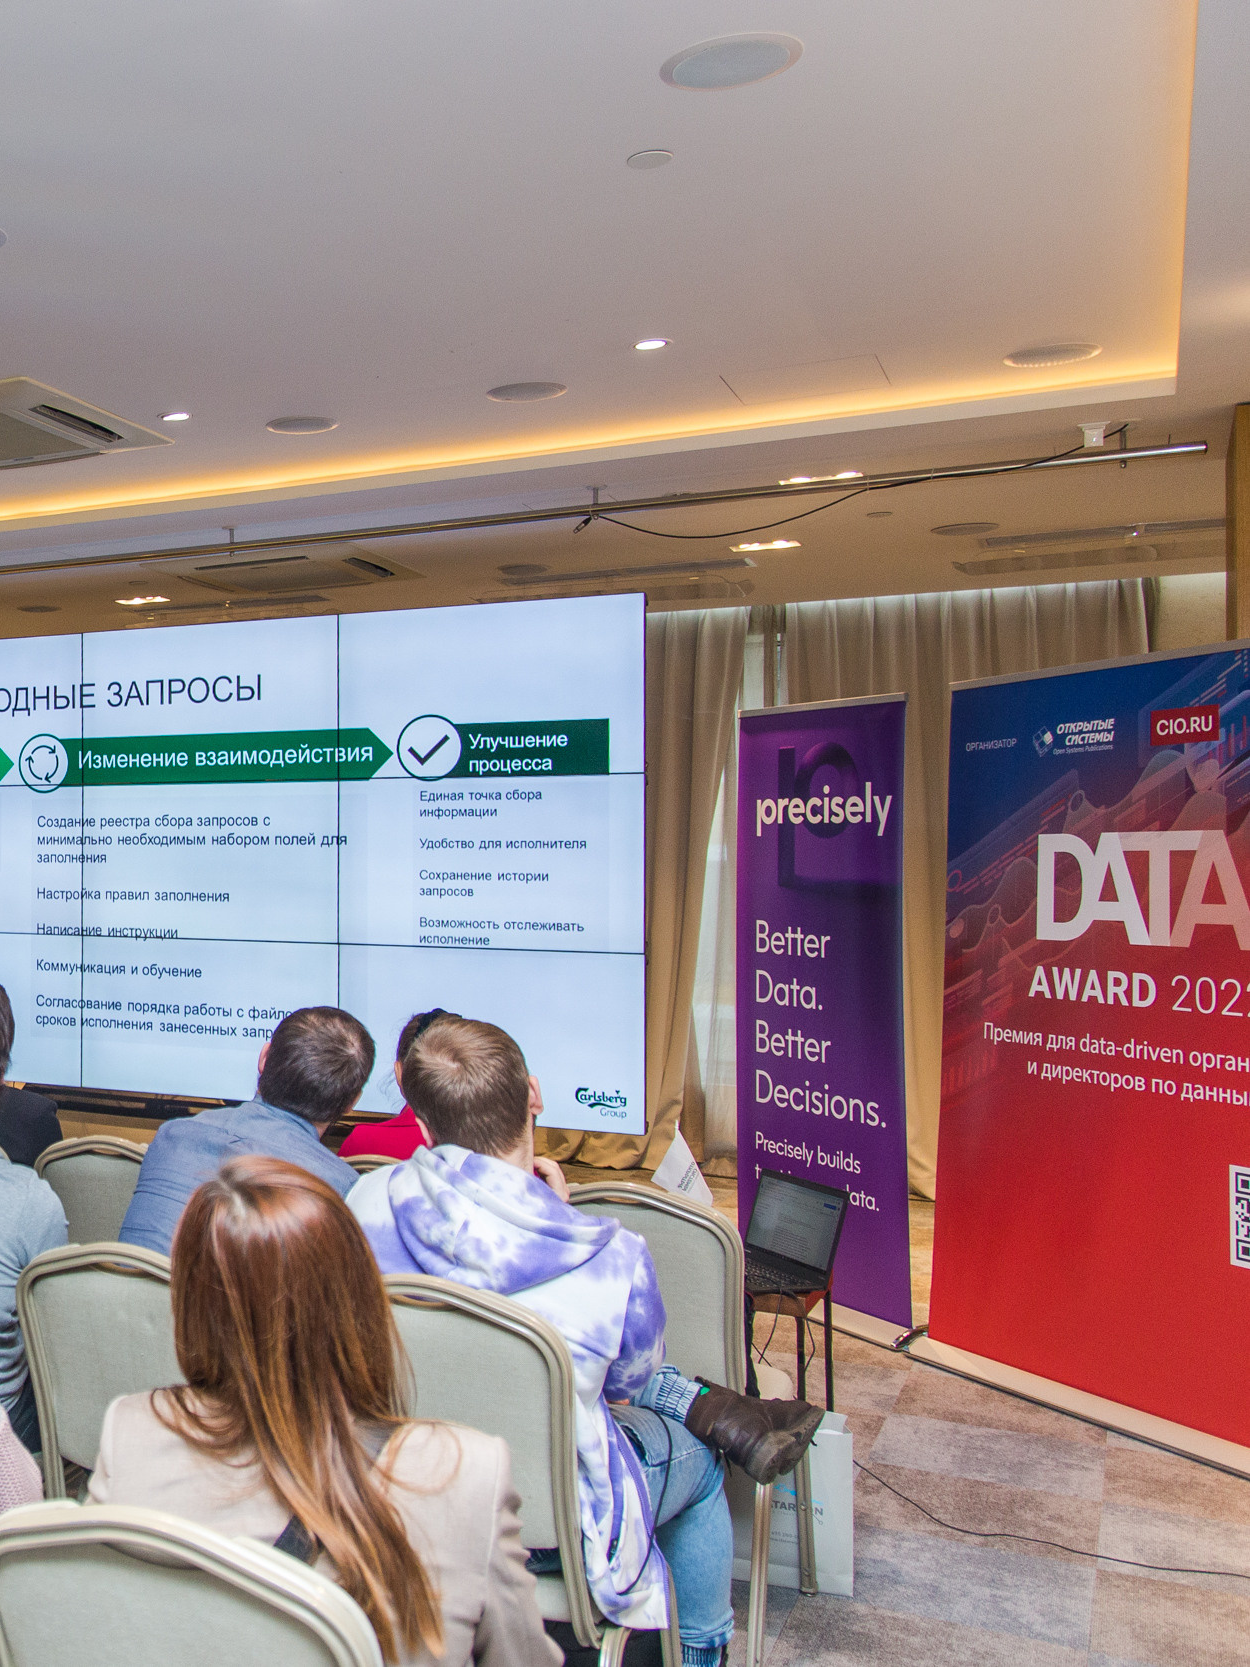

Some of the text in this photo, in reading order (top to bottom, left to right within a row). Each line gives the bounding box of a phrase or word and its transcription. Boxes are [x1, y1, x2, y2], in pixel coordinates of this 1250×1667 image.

[106, 674, 262, 708] ЗАПРОСЫ
[1056, 718, 1115, 735] ОТКРЫТЫЕ
[1156, 715, 1213, 736] CIO.RU
[468, 733, 568, 752] Улучшение
[965, 738, 1017, 751] ОРГАНИЗАТОР
[1065, 731, 1115, 746] СИСТЕМЫ
[78, 743, 373, 769] Изменение взаимодействия
[469, 757, 553, 775] процесса
[420, 789, 542, 802] Единая точка сбора
[420, 806, 498, 819] информации
[756, 782, 893, 837] precisely
[37, 814, 271, 830] Создание реестра сбора запросов с
[37, 832, 348, 848] минимально необходимым набором полей для
[419, 838, 587, 850] Удобство для исполнителя
[36, 853, 107, 863] заполнения
[419, 869, 549, 883] Сохранение истории
[37, 887, 230, 902] Настройка правил заполнения
[419, 887, 474, 898] запросов
[1036, 830, 1250, 951] DATA
[36, 923, 178, 941] Написание инструкции
[419, 917, 585, 932] Возможность отслеживать
[419, 934, 490, 946] исполнение
[755, 919, 831, 958] Better
[36, 959, 202, 979] Коммуникация и обучение
[755, 969, 823, 1010] Data.
[1028, 965, 1250, 1018] AWARD 202
[36, 994, 122, 1011] Согласование
[127, 1001, 180, 1015] порядка
[184, 1003, 232, 1018] работы
[236, 1007, 244, 1018] с
[35, 1014, 76, 1028] сроков
[81, 1016, 153, 1031] исполнения
[159, 1022, 237, 1037] занесенных
[755, 1019, 831, 1063] Better
[983, 1022, 1042, 1046] Премия
[1046, 1033, 1076, 1052] для
[1079, 1033, 1184, 1065] data-driven
[1027, 1060, 1250, 1106] и директоров по данны
[575, 1087, 627, 1107] Carlsberg
[755, 1069, 887, 1128] Decisions.
[600, 1107, 627, 1119] Group
[755, 1131, 814, 1168] Precisely
[817, 1146, 861, 1174] builds
[846, 1184, 880, 1212] ata.
